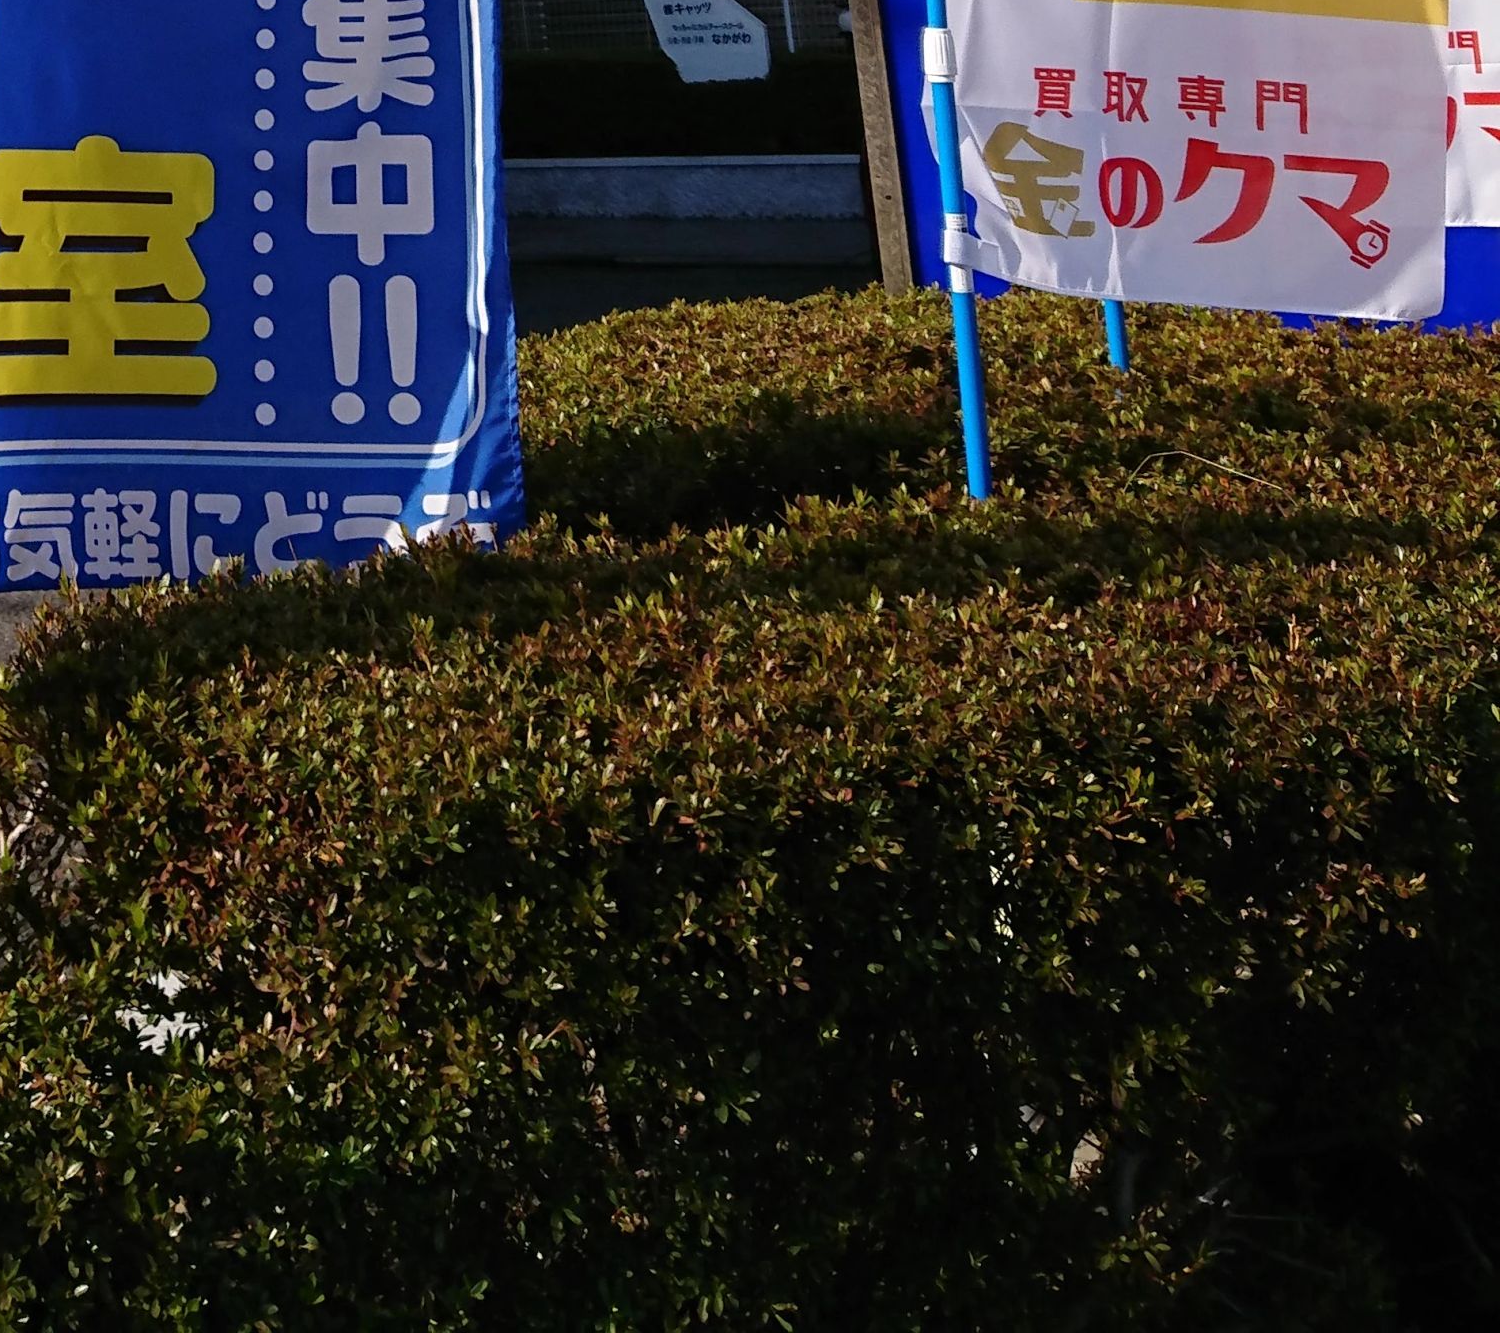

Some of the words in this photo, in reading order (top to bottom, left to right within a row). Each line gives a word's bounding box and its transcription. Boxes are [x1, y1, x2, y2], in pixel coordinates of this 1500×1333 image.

[1033, 67, 1308, 134] 買取専門
[984, 121, 1392, 270] 金のクマ
